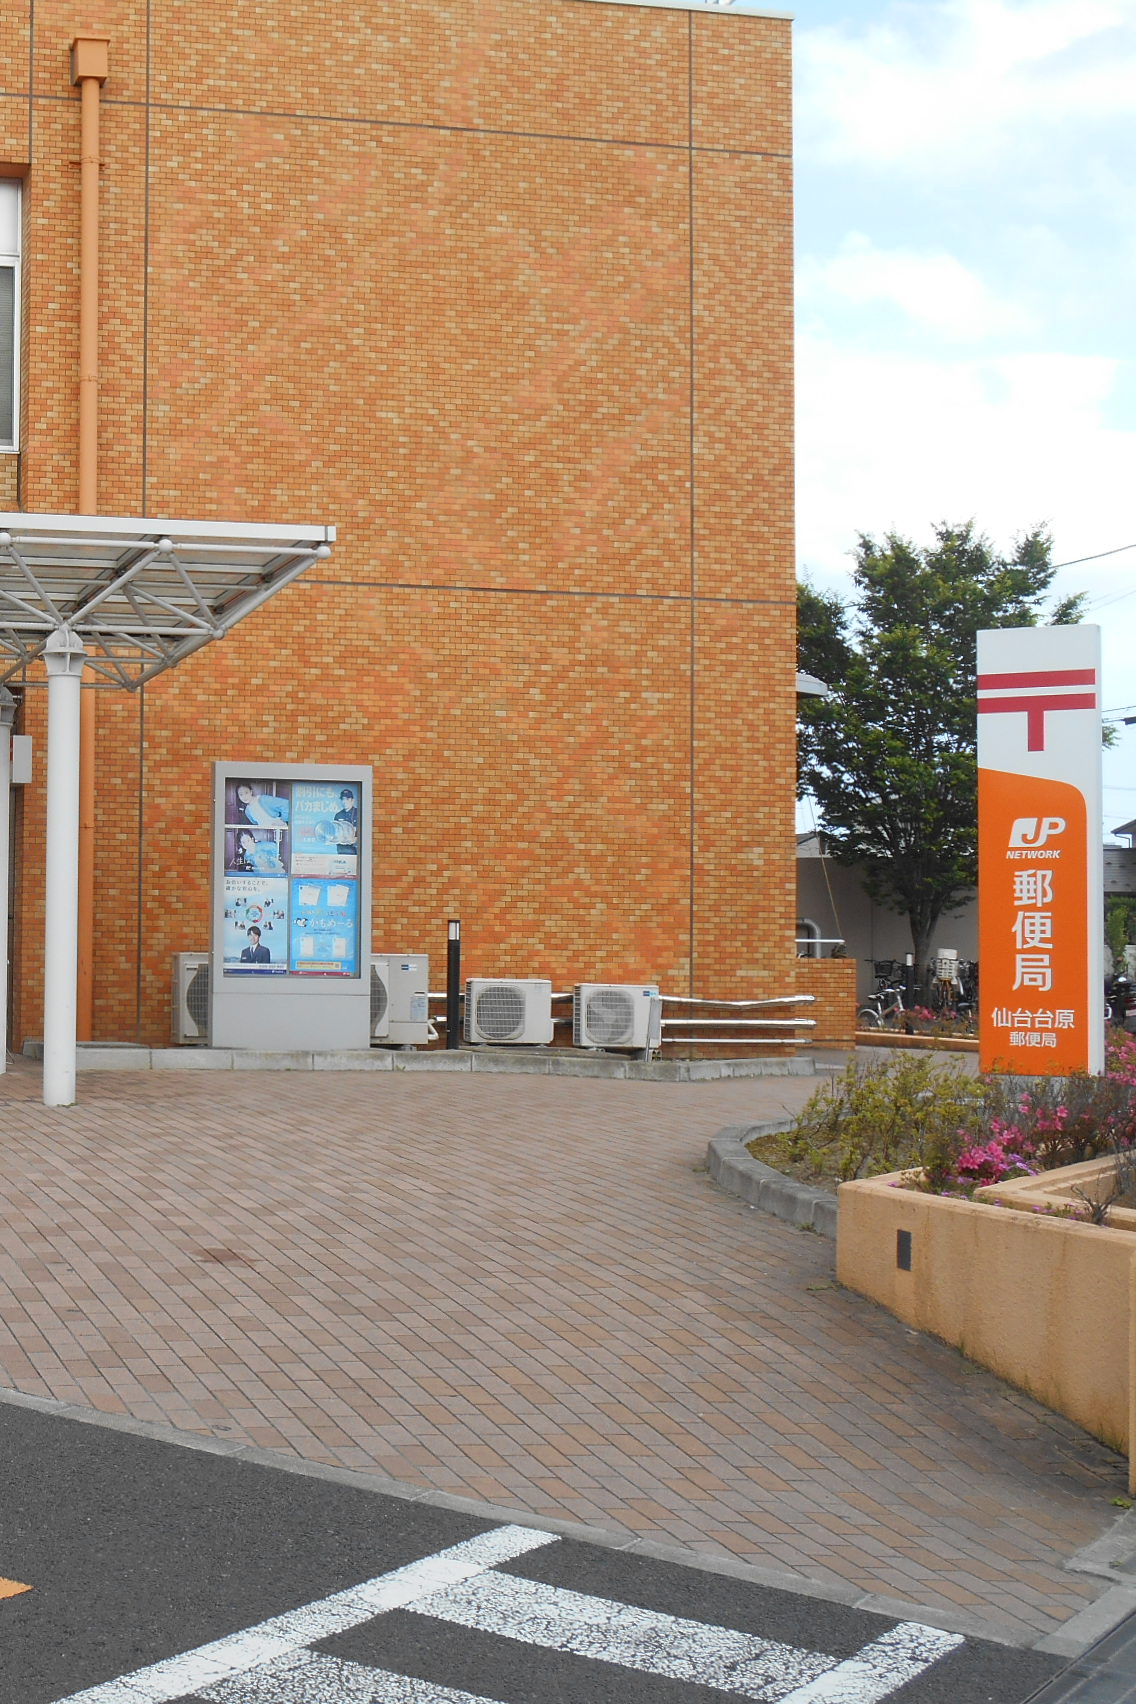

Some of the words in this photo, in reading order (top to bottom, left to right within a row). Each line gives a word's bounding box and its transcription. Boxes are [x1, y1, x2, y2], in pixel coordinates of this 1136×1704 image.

[1006, 850, 1061, 860] NETWORK
[1012, 868, 1053, 992] 郵便局
[991, 1007, 1075, 1029] 仙台台原
[1009, 1031, 1057, 1048] 郵便局
